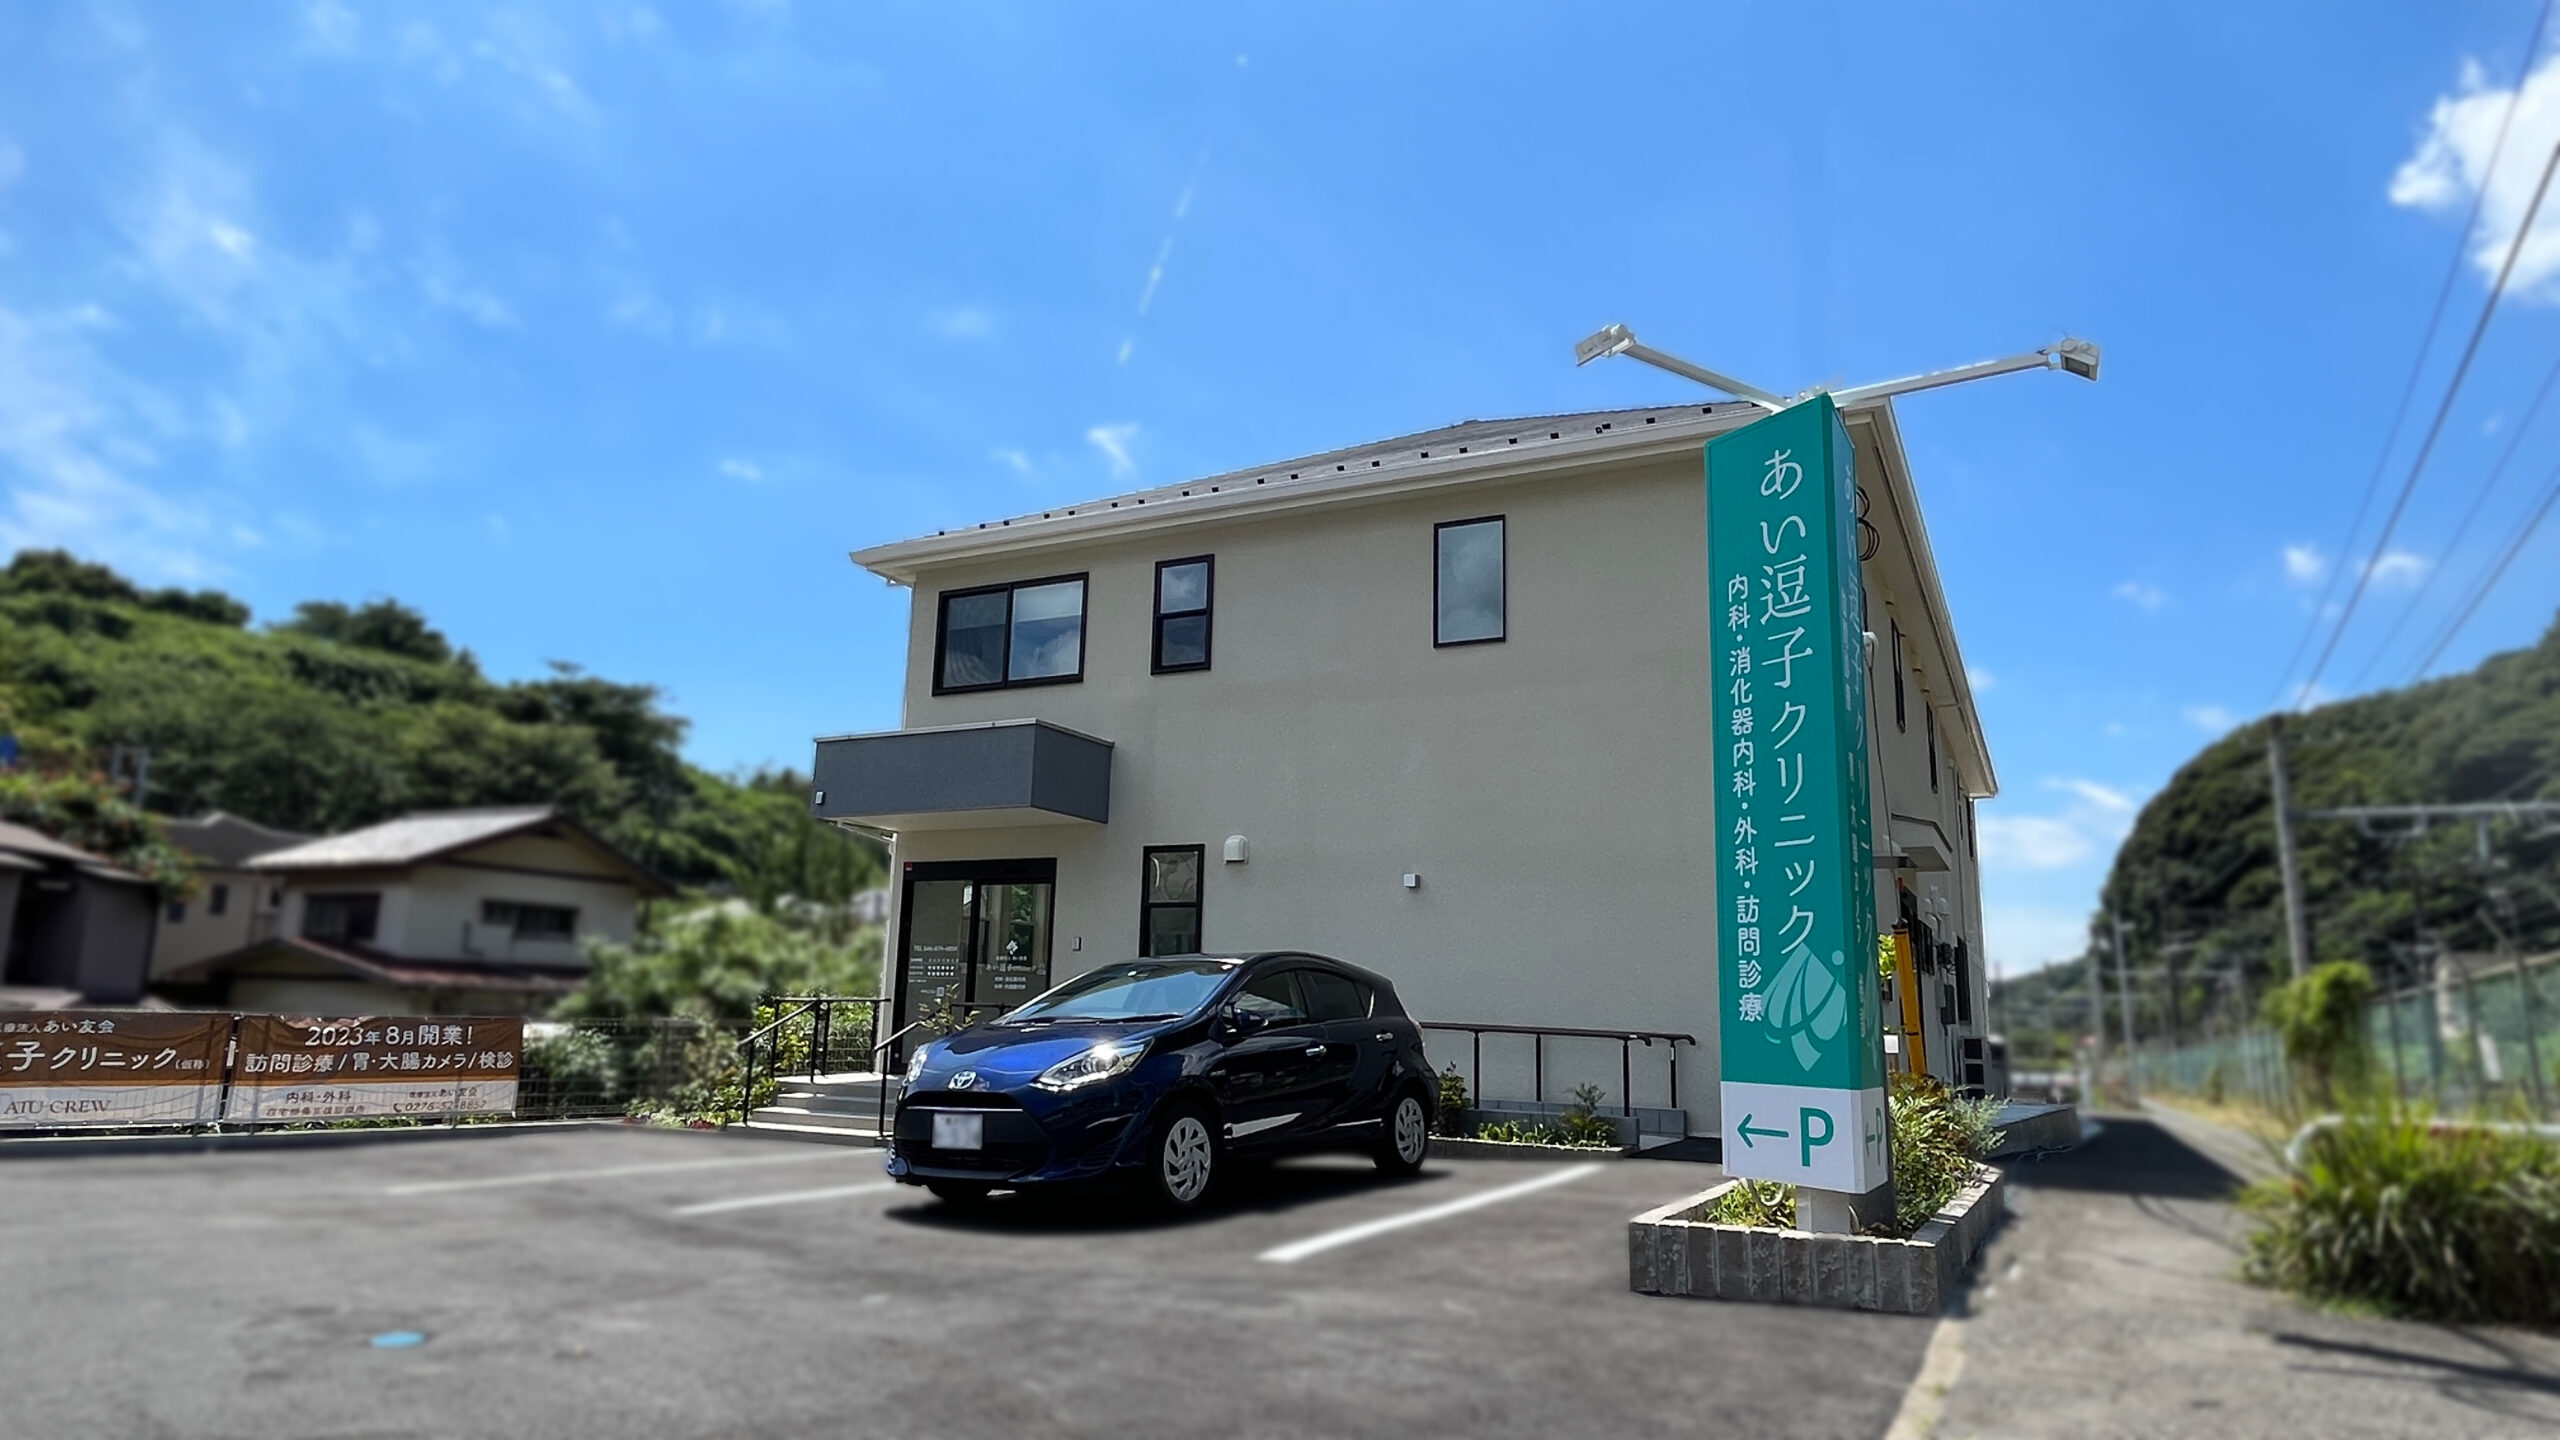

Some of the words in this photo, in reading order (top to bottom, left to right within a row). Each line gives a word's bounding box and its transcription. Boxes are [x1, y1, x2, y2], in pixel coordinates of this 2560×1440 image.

[1727, 573, 1764, 1023] 内科・消化器内科・外科・訪問診療
[1760, 448, 1815, 955] あい逗子クリニック
[1799, 1106, 1835, 1168] P
[1875, 1106, 1883, 1167] P
